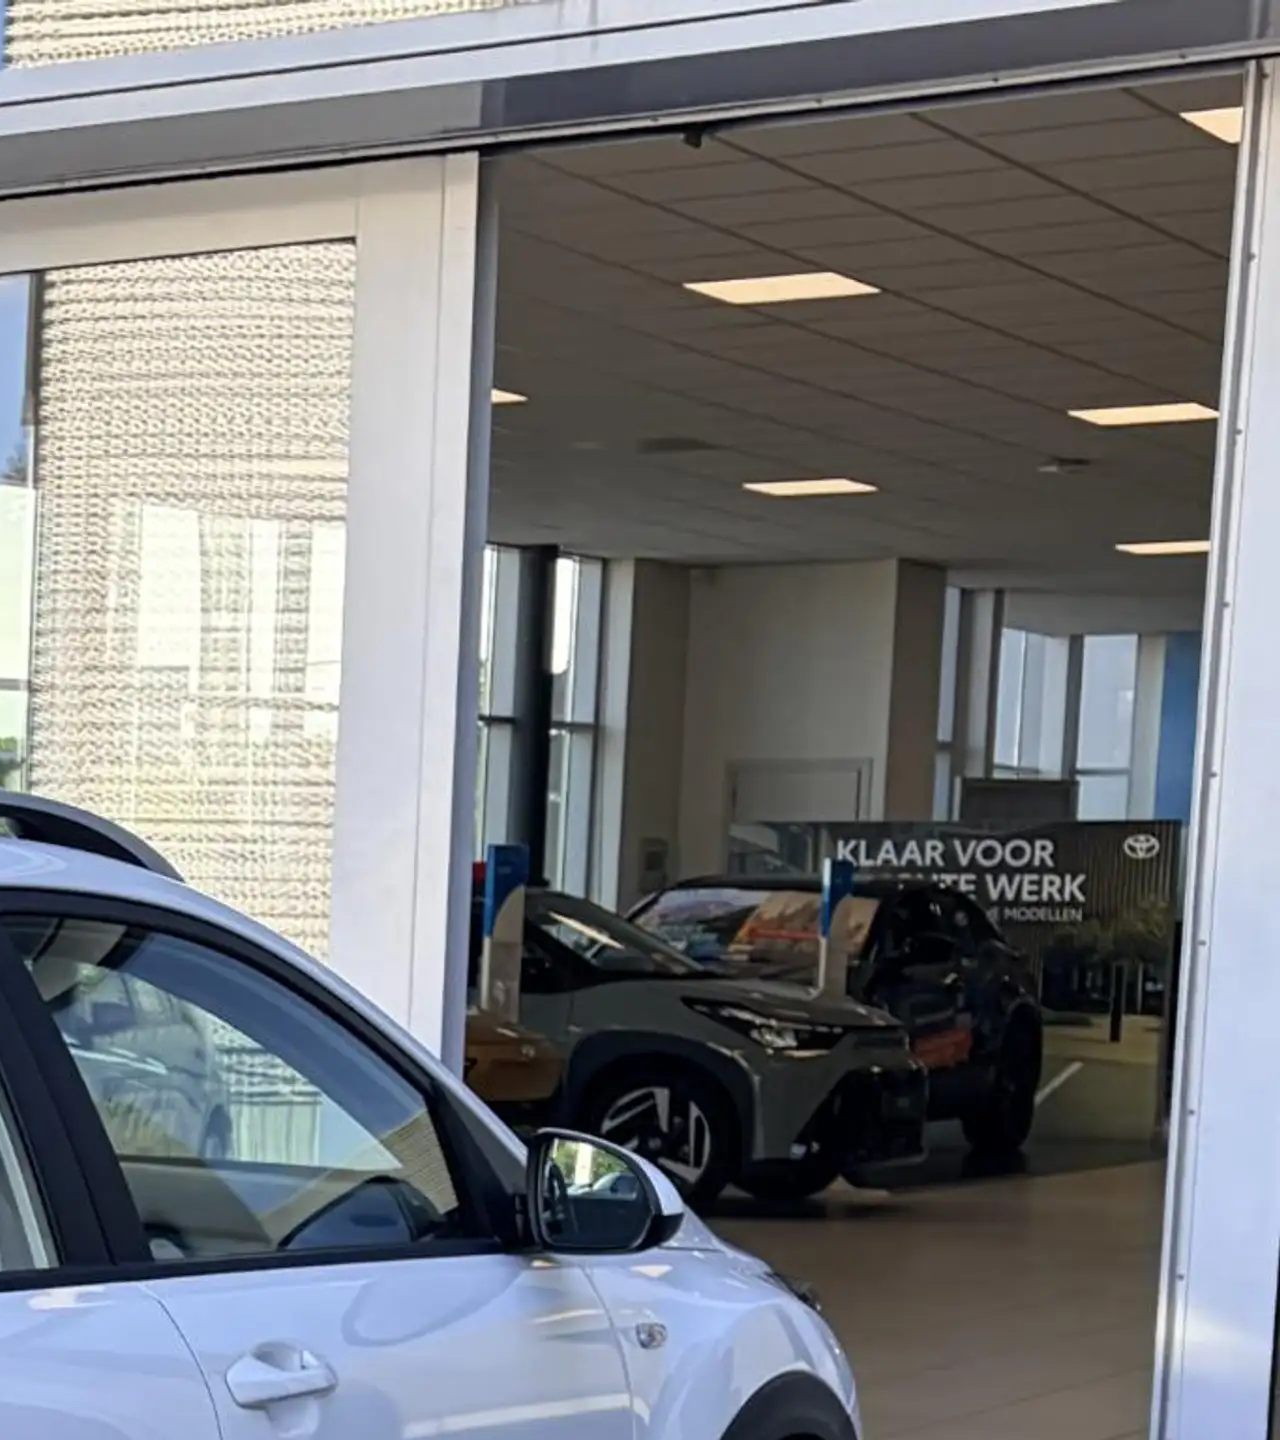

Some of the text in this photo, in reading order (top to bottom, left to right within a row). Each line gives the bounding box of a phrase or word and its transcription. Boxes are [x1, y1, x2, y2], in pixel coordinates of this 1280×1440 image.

[837, 839, 1054, 868] KLAAR VOOR
[986, 873, 1086, 902] WERK
[1004, 907, 1083, 923] MODELLEN
